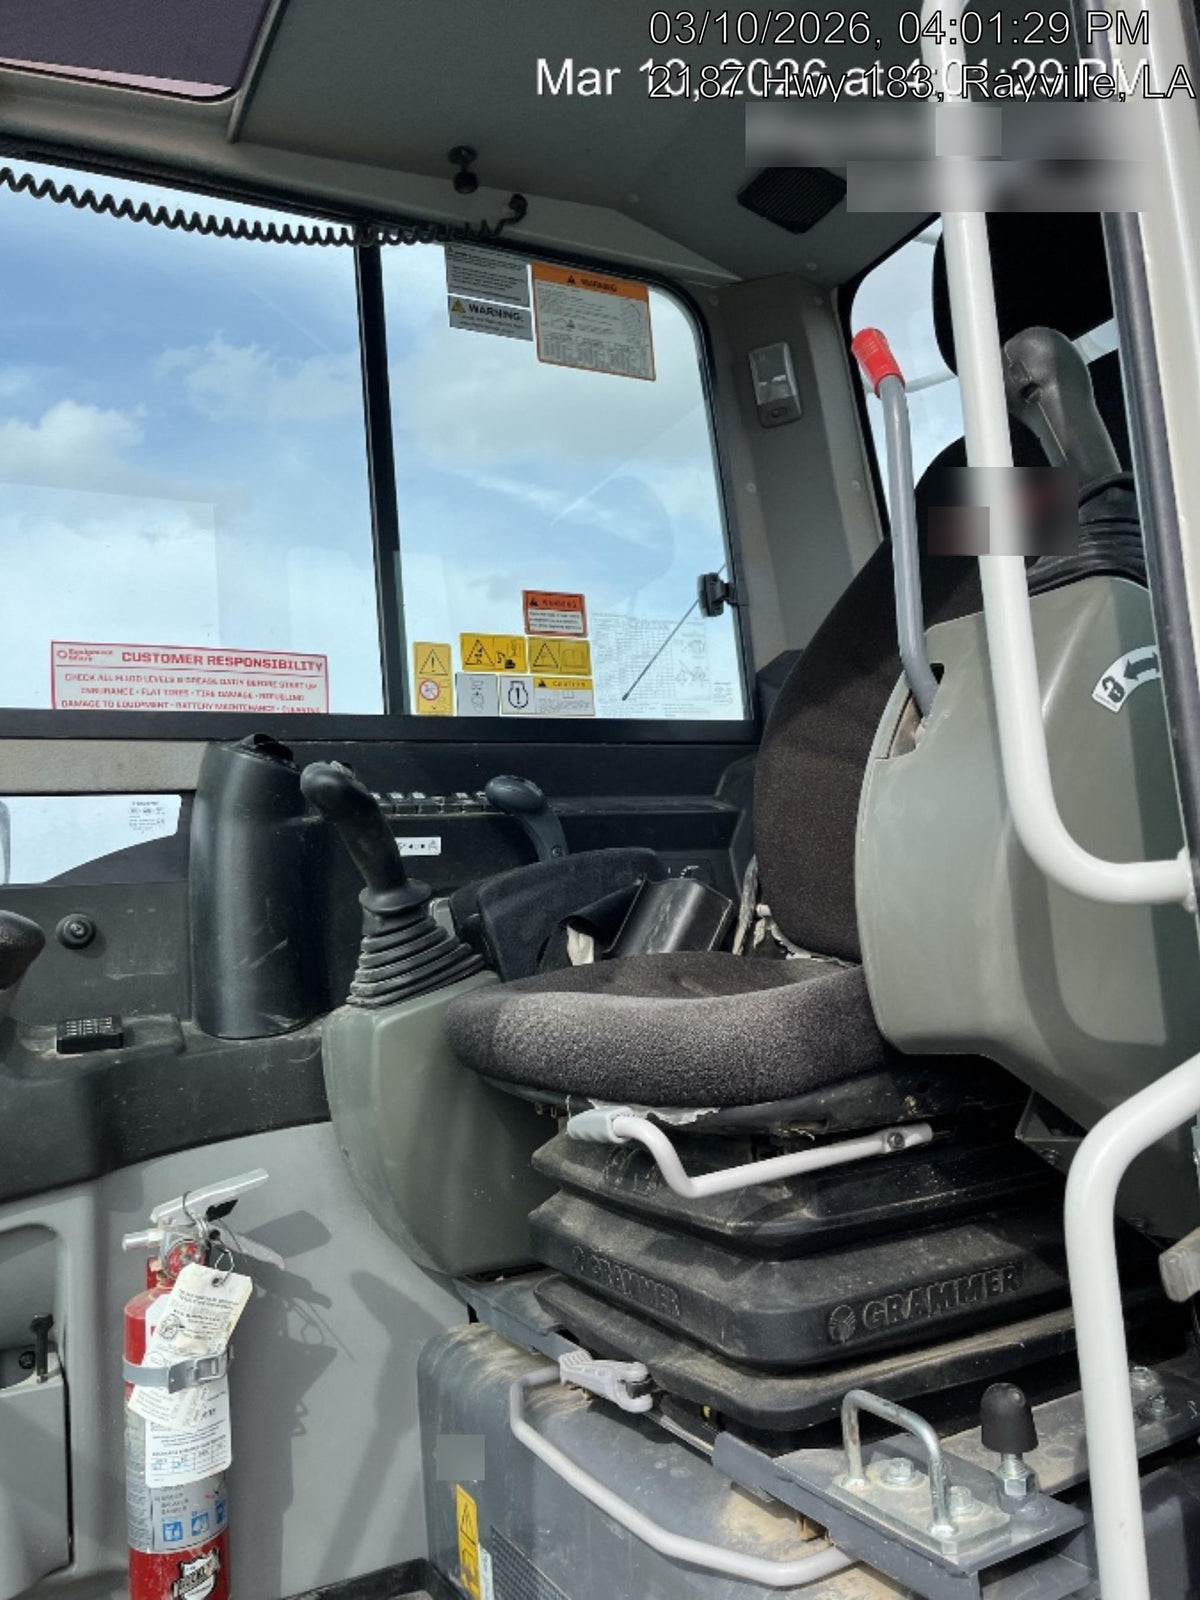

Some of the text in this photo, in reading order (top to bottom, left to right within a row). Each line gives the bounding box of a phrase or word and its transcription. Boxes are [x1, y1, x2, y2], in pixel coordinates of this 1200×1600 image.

[122, 652, 323, 672] CUSTOMER RESPONSIBILITY
[65, 673, 95, 682] CHECK
[97, 674, 113, 682] ALL
[103, 700, 114, 708] TO
[862, 1264, 1024, 1331] GRAMMER
